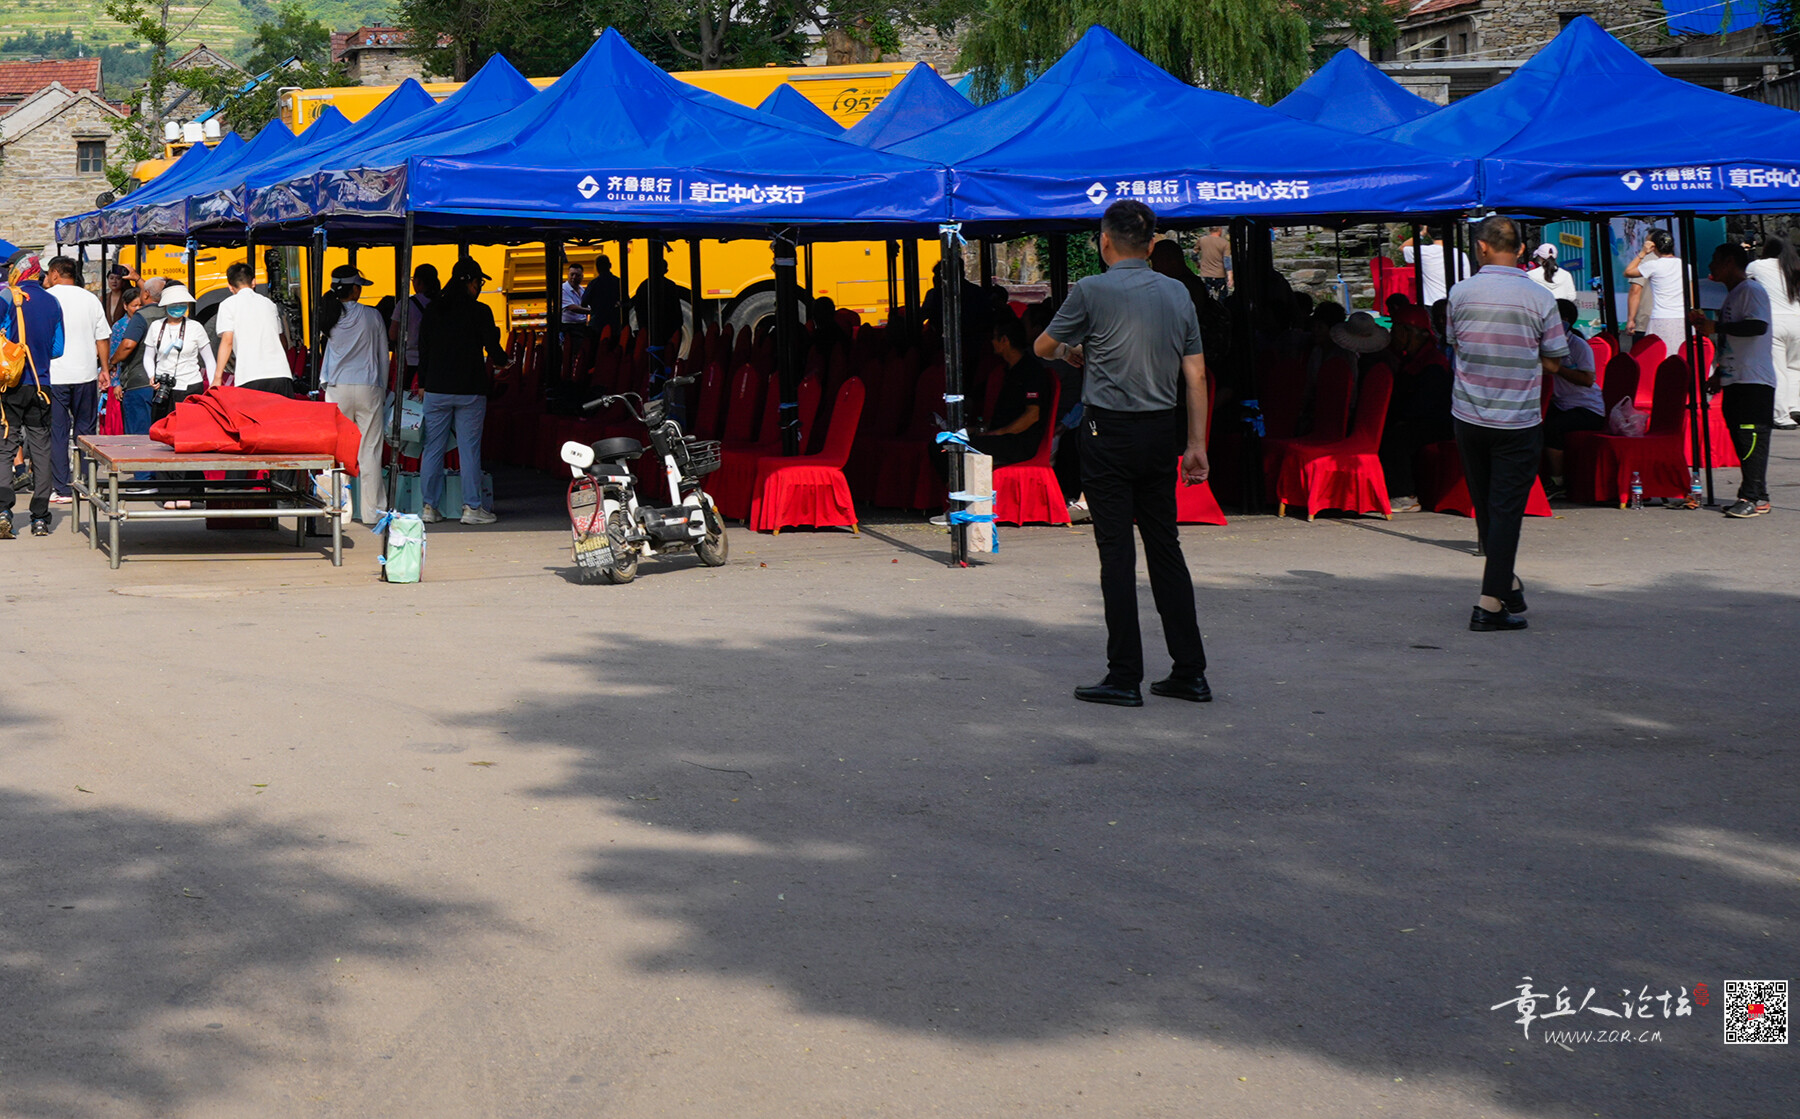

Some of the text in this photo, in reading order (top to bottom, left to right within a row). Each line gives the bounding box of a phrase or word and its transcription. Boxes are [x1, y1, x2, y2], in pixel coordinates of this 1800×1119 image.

[1649, 166, 1711, 182] 齐鲁银行
[1728, 168, 1800, 188] 章丘中心
[607, 176, 672, 193] 齐鲁银行
[1115, 180, 1178, 196] 齐鲁银行
[1196, 180, 1309, 201] 章丘中心支行
[1652, 182, 1713, 191] QILU BANK
[607, 192, 671, 202] QILU BANK
[689, 182, 806, 204] 章丘中心支行
